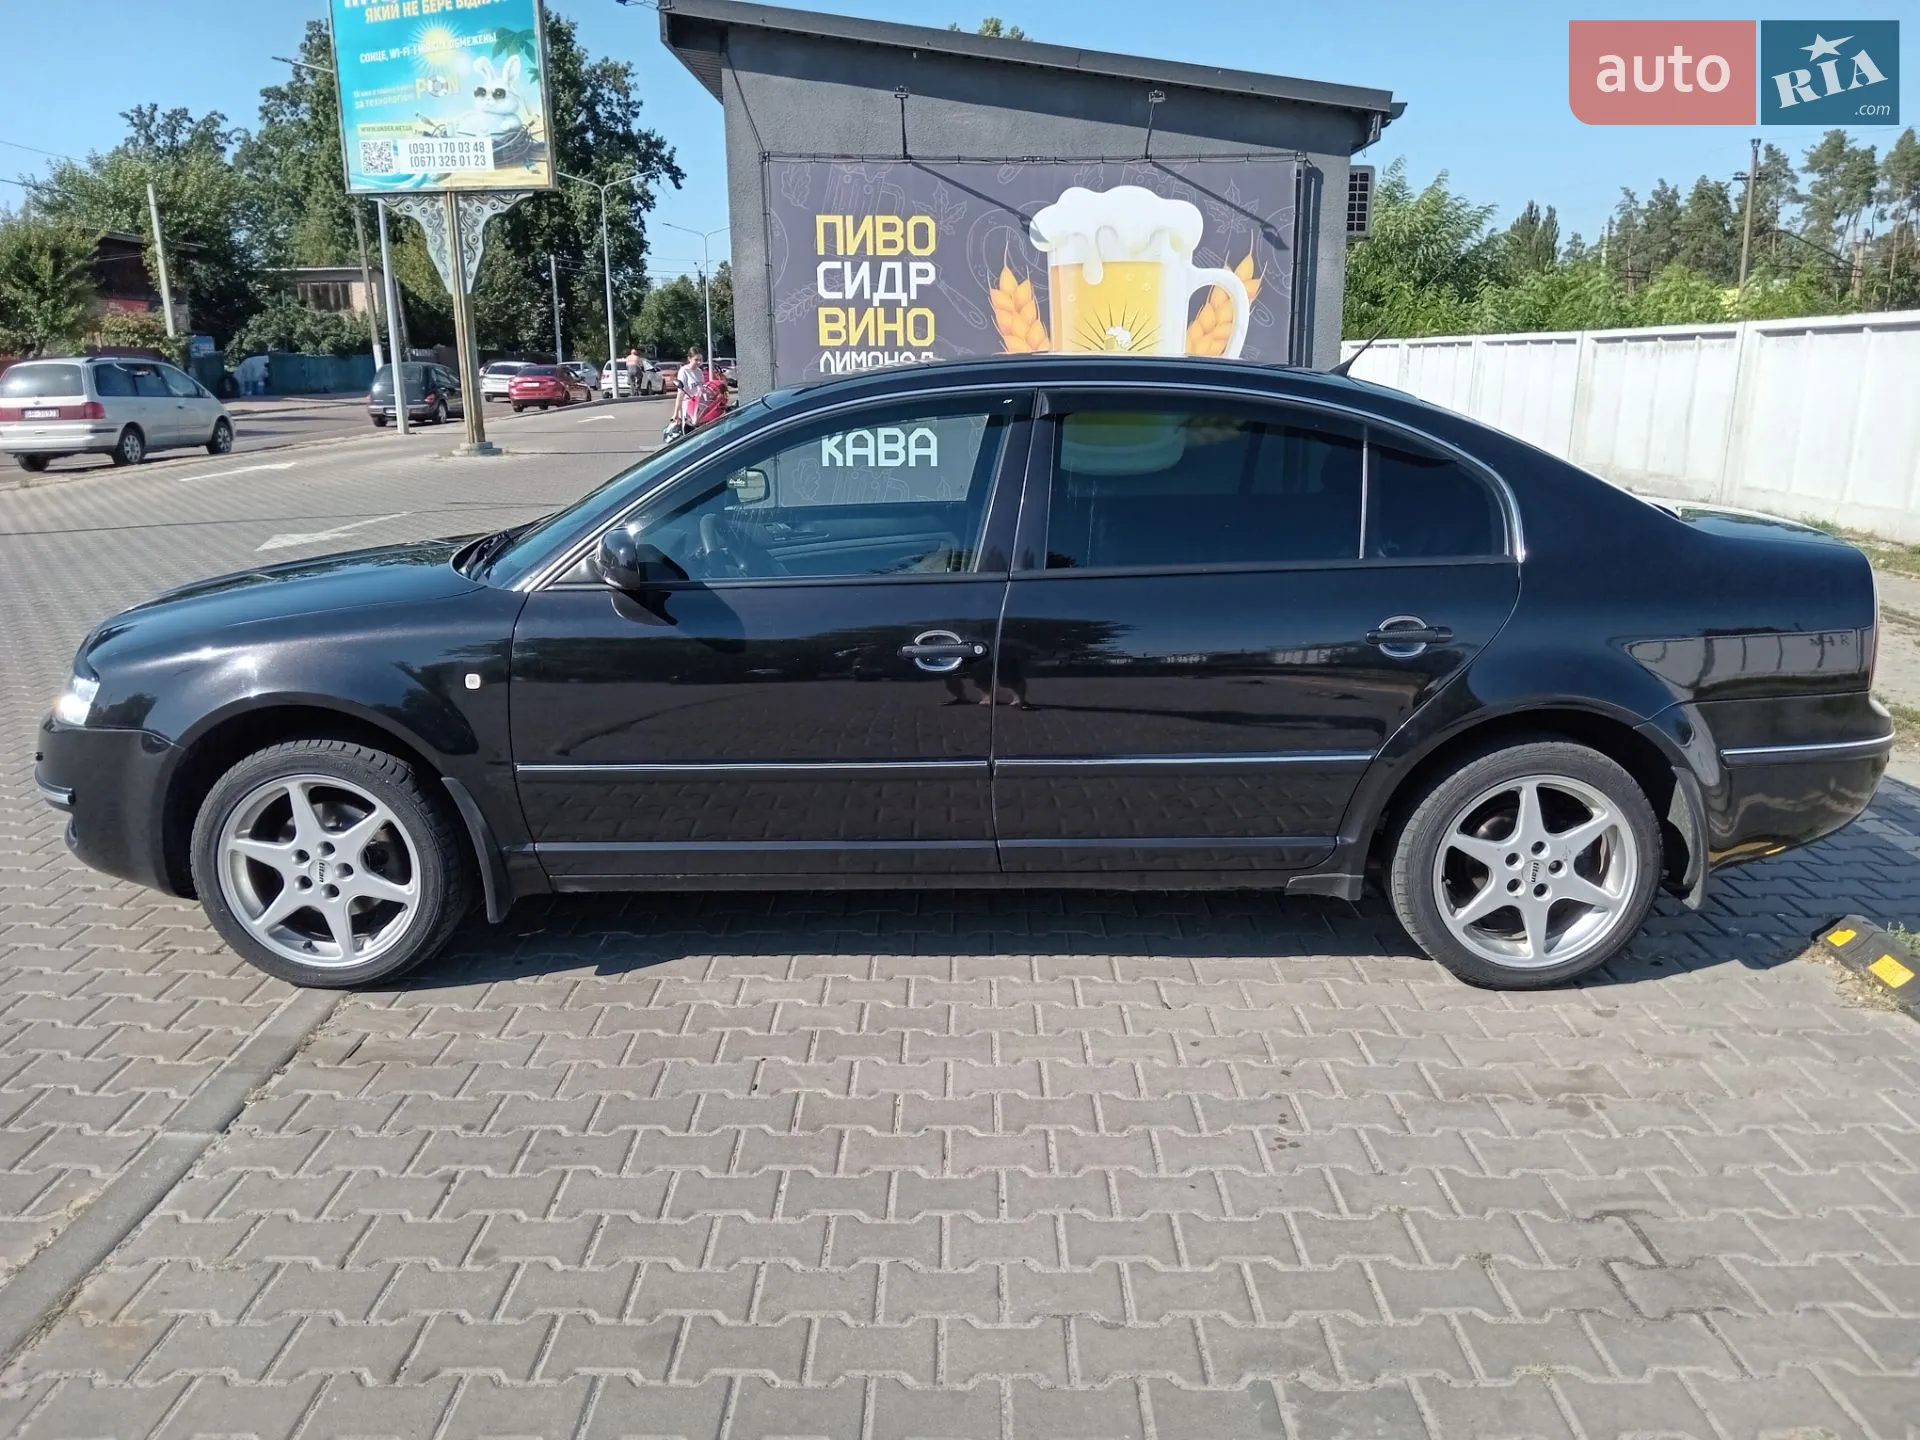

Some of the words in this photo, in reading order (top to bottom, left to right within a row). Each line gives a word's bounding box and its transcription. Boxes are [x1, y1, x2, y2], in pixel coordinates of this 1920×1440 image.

[365, 4, 400, 24] ЯКИЙ
[403, 1, 419, 17] НЕ
[422, 0, 453, 14] БЕРЕ
[360, 50, 388, 63] СОНЦЕ,
[408, 142, 435, 155] (093)
[438, 141, 456, 154] 170
[458, 141, 470, 153] 03
[472, 141, 485, 153] 48
[409, 155, 436, 167] (067)
[438, 155, 457, 167] 326
[459, 154, 471, 167] 01
[473, 154, 487, 166] 23
[815, 215, 936, 256] ПИВО
[816, 261, 936, 307] СИДР
[817, 307, 935, 347] ВИНО
[821, 427, 938, 467] КАВА
[1531, 862, 1539, 883] titan
